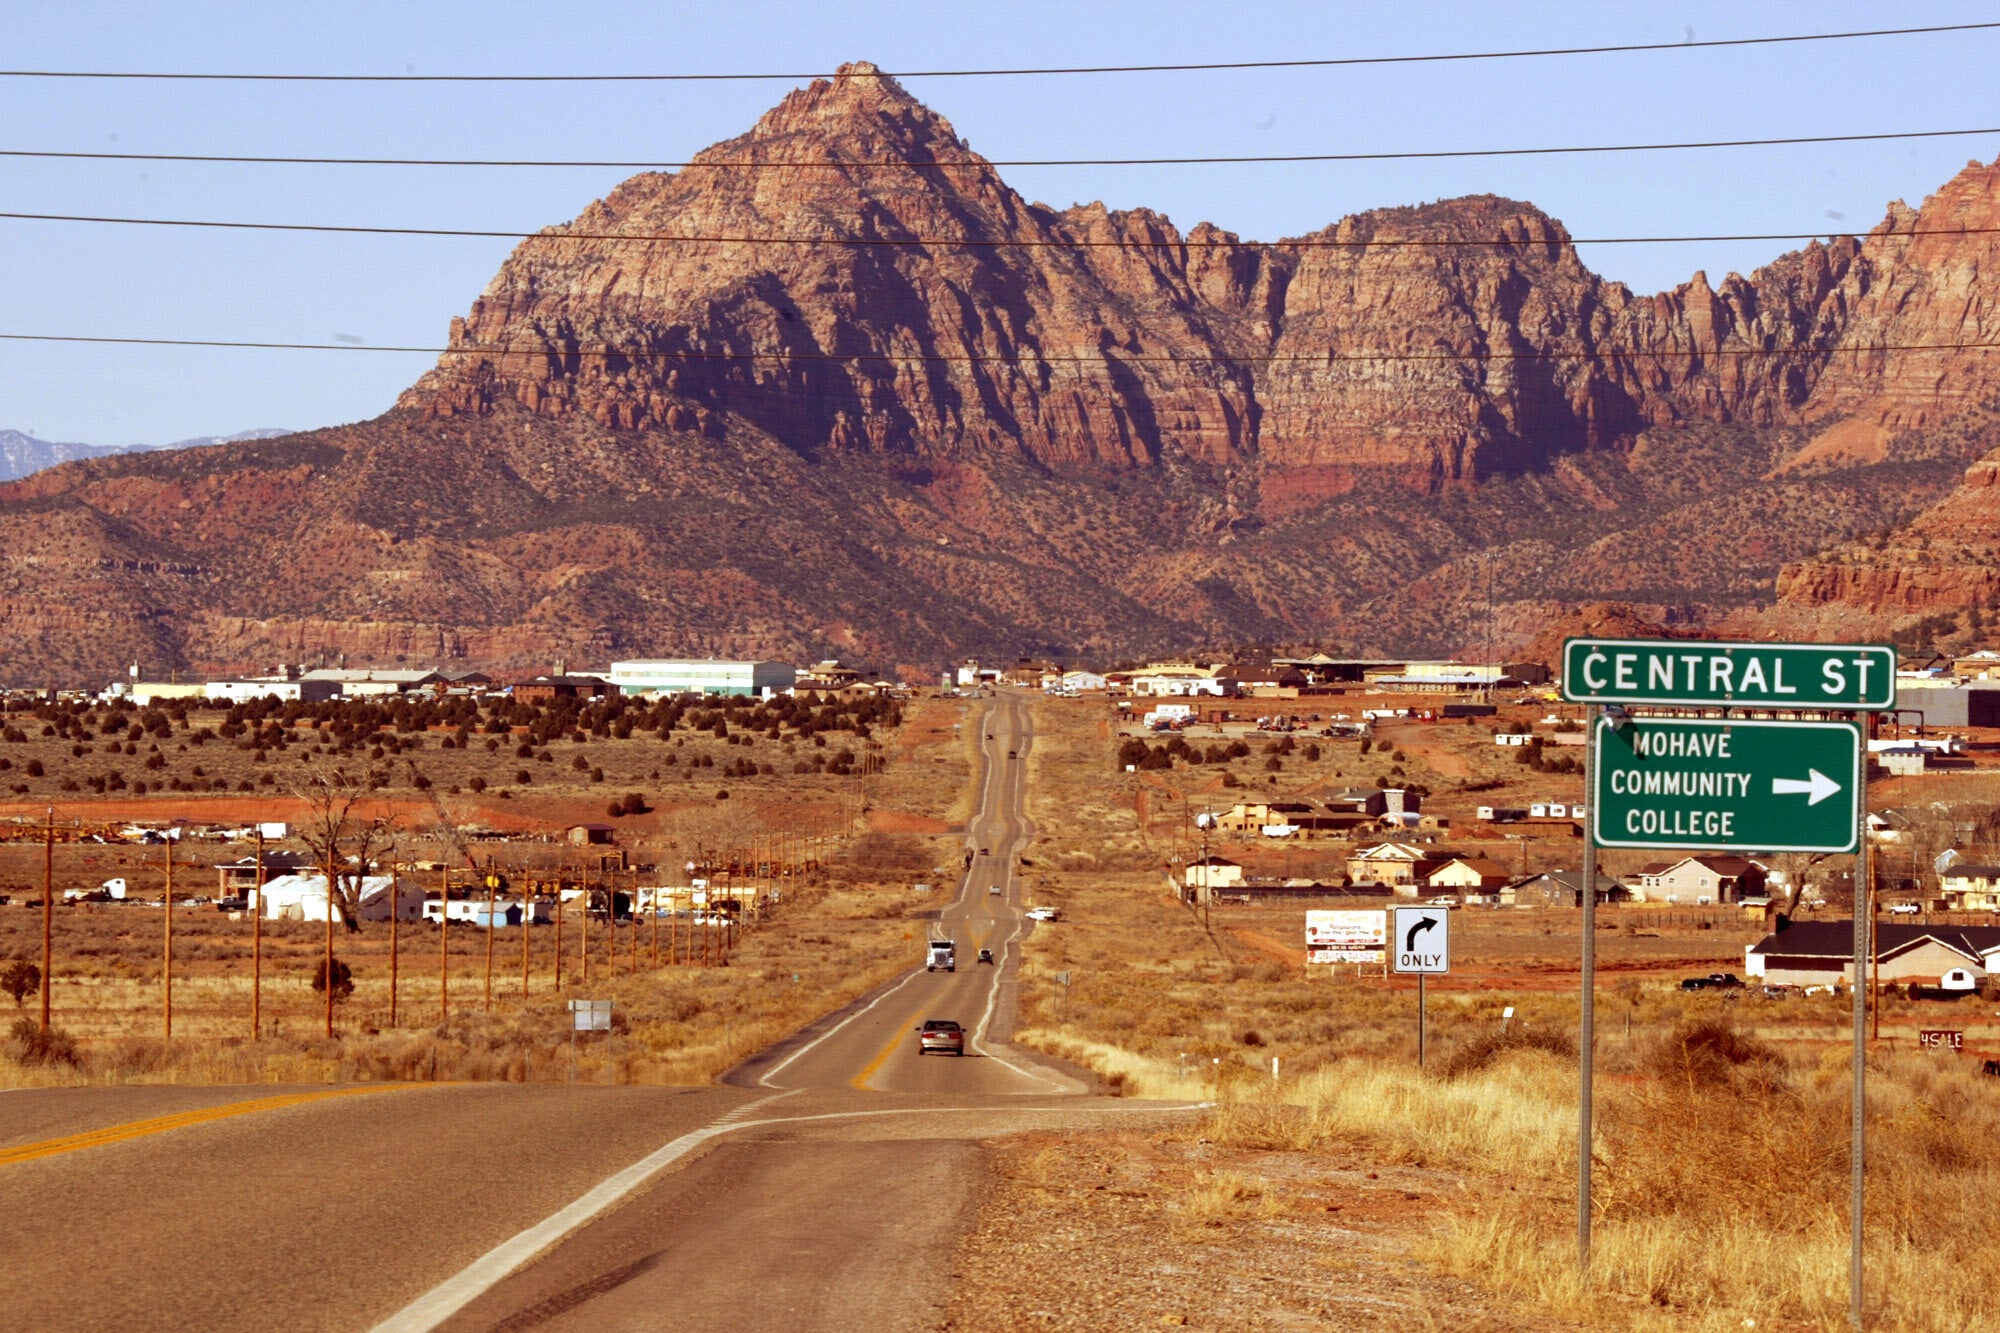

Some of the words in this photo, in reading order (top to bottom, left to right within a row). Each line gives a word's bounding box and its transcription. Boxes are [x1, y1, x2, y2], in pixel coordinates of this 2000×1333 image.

[1583, 653, 1797, 693] CENTRAL
[1821, 658, 1875, 695] ST
[1633, 732, 1732, 758] MOHAVE
[1611, 770, 1752, 798] COMMUNITY
[1626, 809, 1735, 836] COLLEGE
[1401, 954, 1441, 967] ONLY
